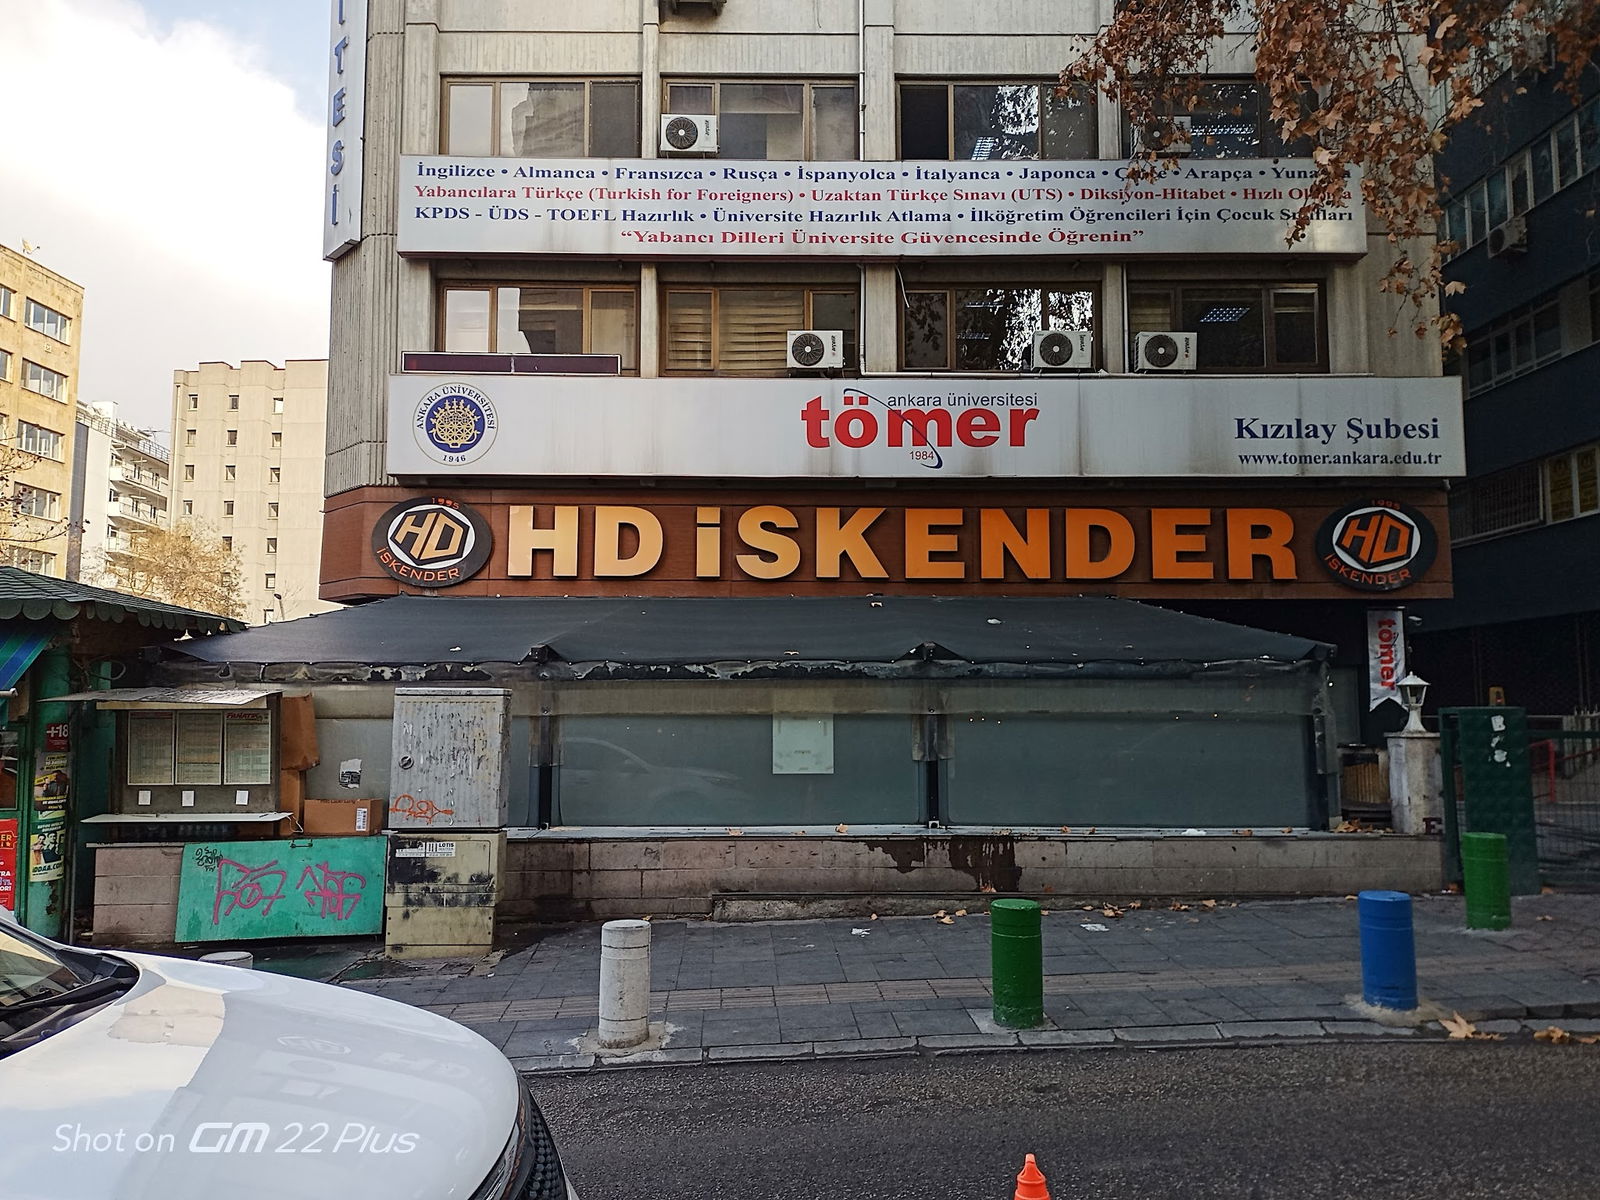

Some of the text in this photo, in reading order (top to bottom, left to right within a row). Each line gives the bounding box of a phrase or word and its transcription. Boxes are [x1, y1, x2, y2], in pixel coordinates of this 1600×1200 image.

[417, 161, 496, 181] İngilizce
[513, 166, 595, 179] Almanca
[615, 167, 703, 180] Fransızca
[723, 167, 778, 183] Rusça
[797, 166, 896, 183] İspanyolca
[916, 166, 1000, 183] İtalyanca
[1019, 168, 1096, 183] Japonca
[1185, 167, 1252, 184] Arapça
[414, 185, 516, 199] Yabancılara
[522, 186, 583, 202] Türkçe
[588, 187, 661, 202] (Turkish
[667, 188, 692, 201] for
[697, 189, 794, 203] Foreigners)
[811, 189, 880, 202] Uzaktan
[887, 189, 948, 204] Türkçe
[953, 189, 1006, 202] Sınavı
[1011, 188, 1062, 203] (UTS)
[1080, 189, 1225, 203] Diksiyon-Hitabet
[1243, 188, 1283, 200] Hızlı
[414, 207, 470, 219] KPDS
[488, 205, 529, 221] ÜDS
[547, 208, 616, 221] TOEFL
[622, 209, 695, 222] Hazırlık
[713, 206, 803, 222] Üniversite
[809, 210, 881, 223] Hazırlık
[887, 210, 951, 223] Atlama
[970, 206, 1064, 224] İlköğretim
[1069, 206, 1171, 222] Öğrencileri
[1177, 206, 1210, 222] İçin
[1216, 208, 1275, 222] Çocuk
[721, 231, 785, 244] Dilleri
[791, 229, 894, 244] Üniversite
[901, 230, 1042, 244] Güvencesinde
[416, 385, 496, 430] ANKARA ÜNİVERSİTESİ
[887, 393, 1038, 406] ankara üniversitesi
[801, 396, 1040, 448] tömer
[1234, 417, 1439, 444] Kızılay Şubesi
[442, 454, 467, 463] 1946
[909, 450, 935, 460] 1984
[1238, 451, 1442, 465] www.tomer.ankara.edu.tr
[394, 512, 464, 560] HD
[507, 505, 663, 577] HD
[1341, 514, 1413, 564] HD
[1378, 618, 1397, 691] tömer
[46, 724, 69, 738] +18
